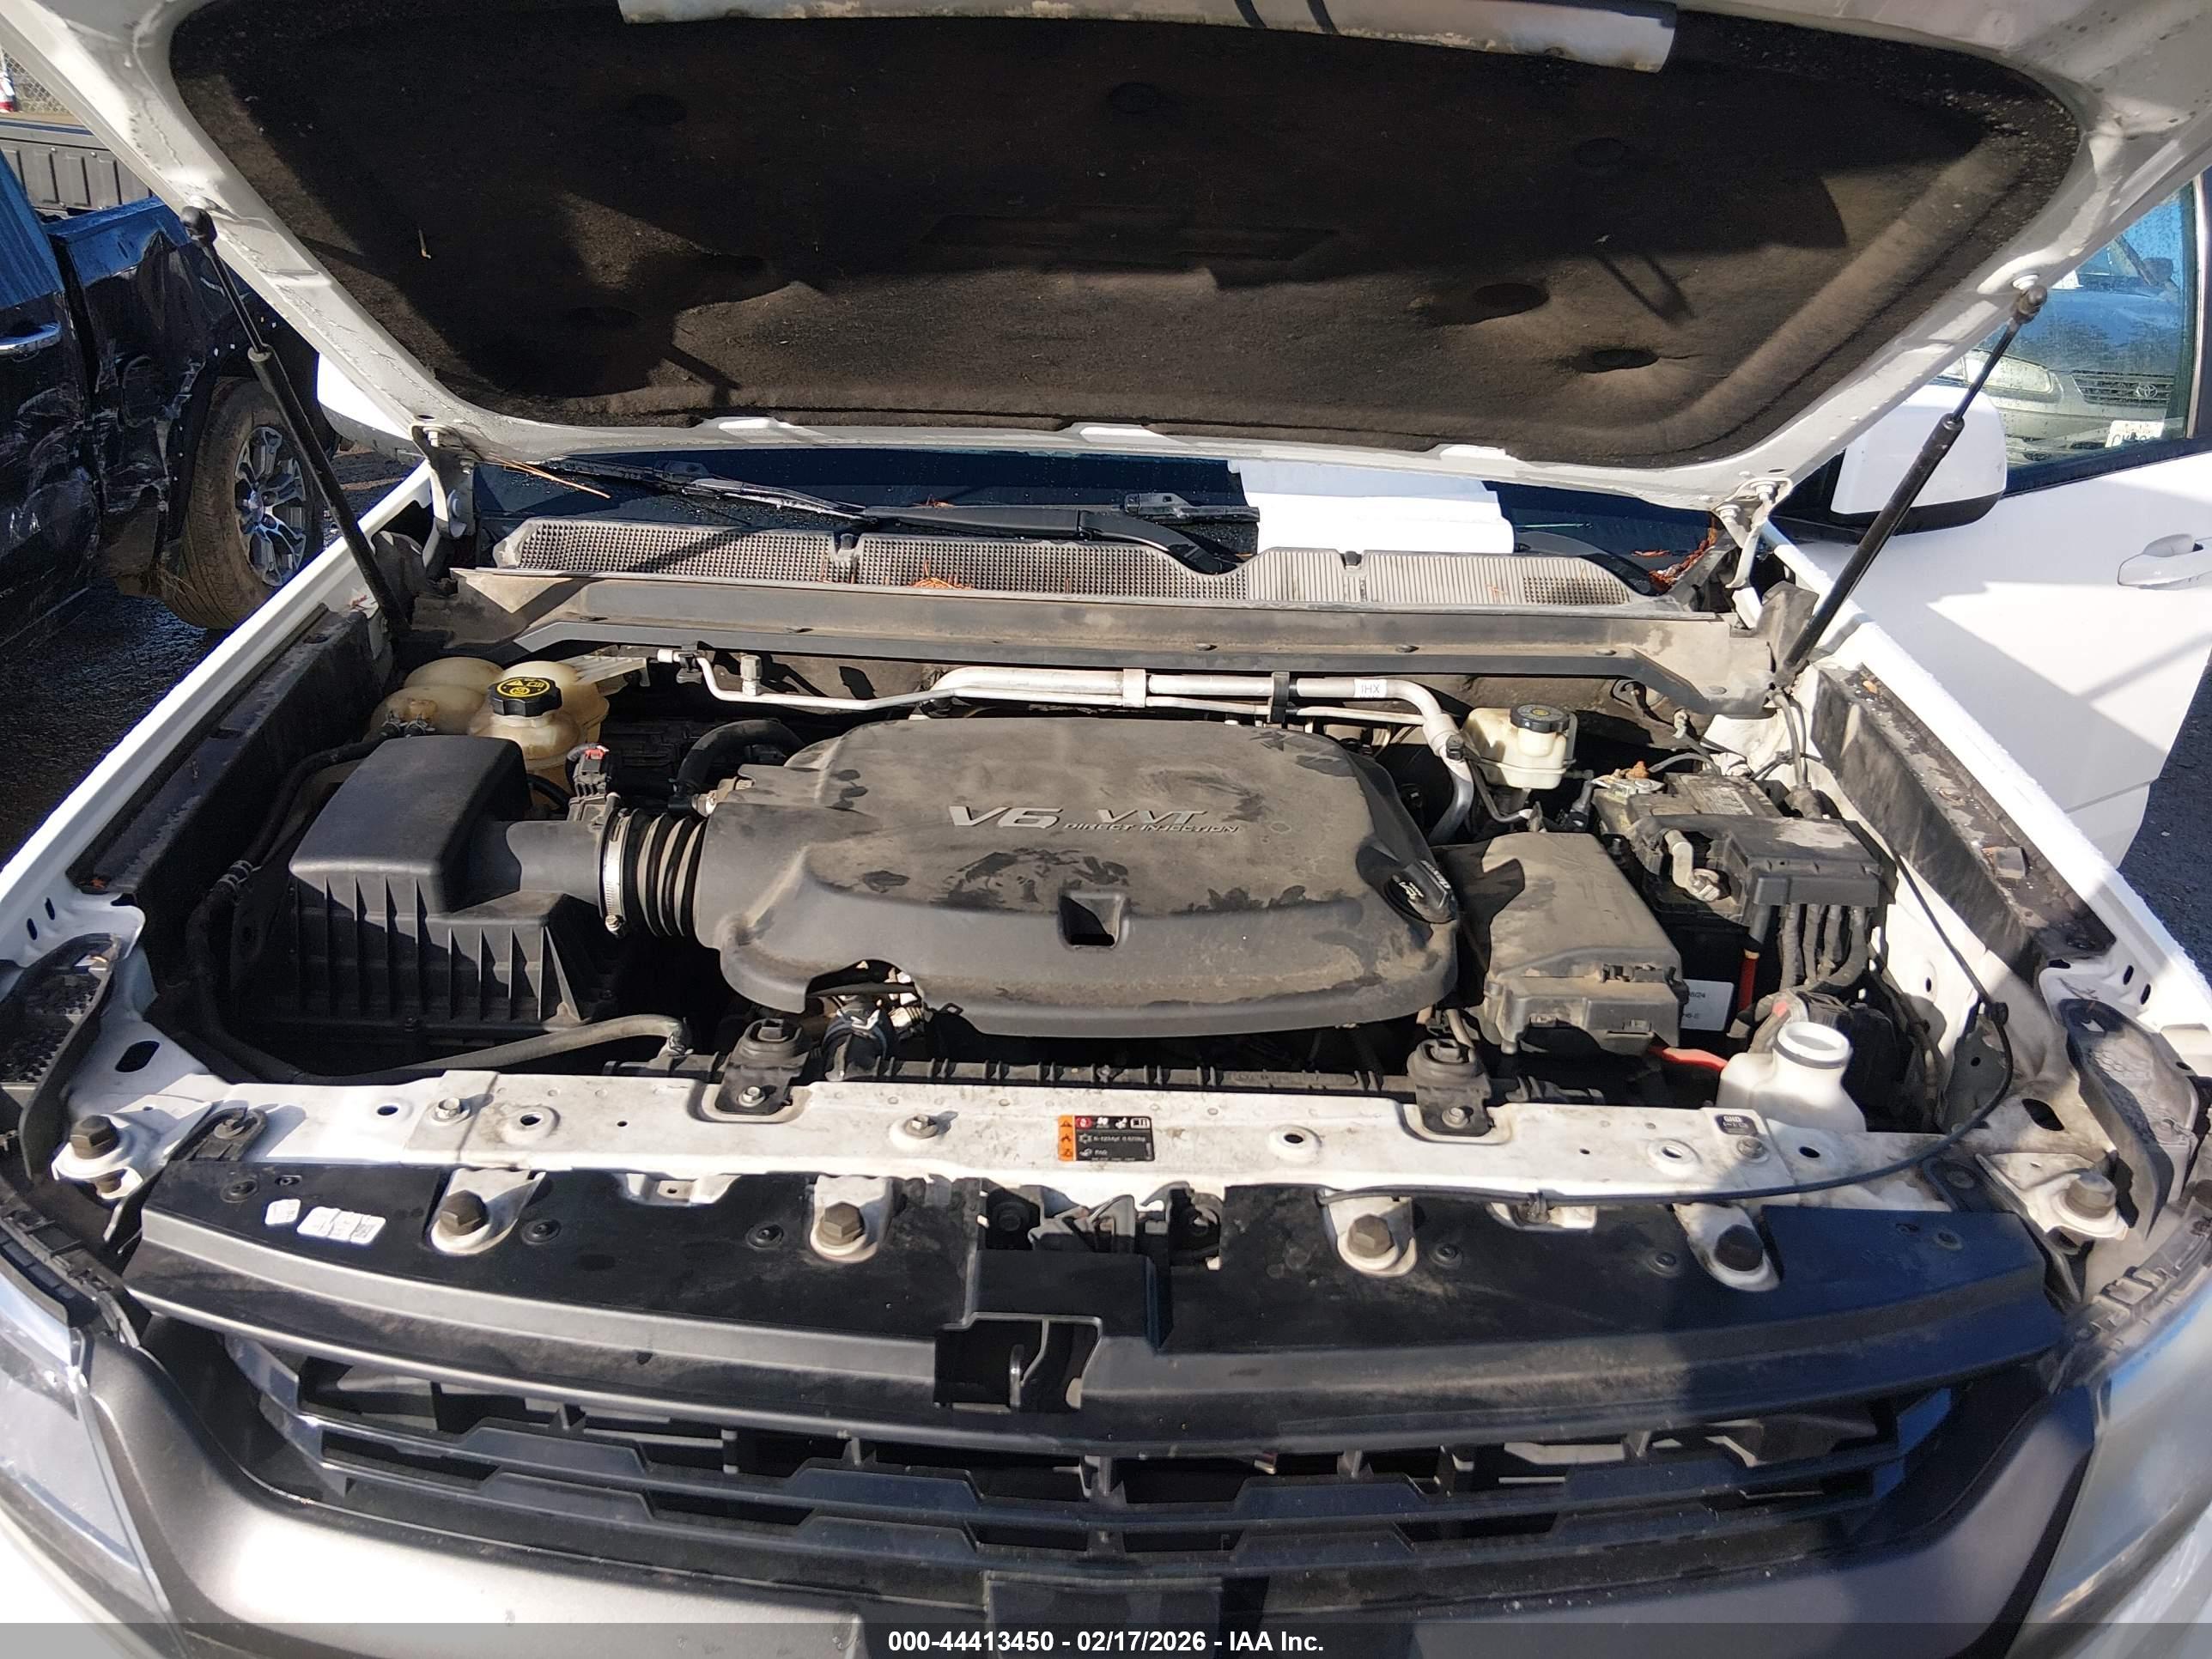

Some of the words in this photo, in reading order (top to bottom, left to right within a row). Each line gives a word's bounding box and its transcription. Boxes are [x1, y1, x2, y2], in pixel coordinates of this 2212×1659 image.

[948, 805, 1064, 830] V6
[1097, 808, 1208, 825] VVT
[1064, 823, 1136, 832] DIRECT
[1139, 824, 1240, 834] INJECTION
